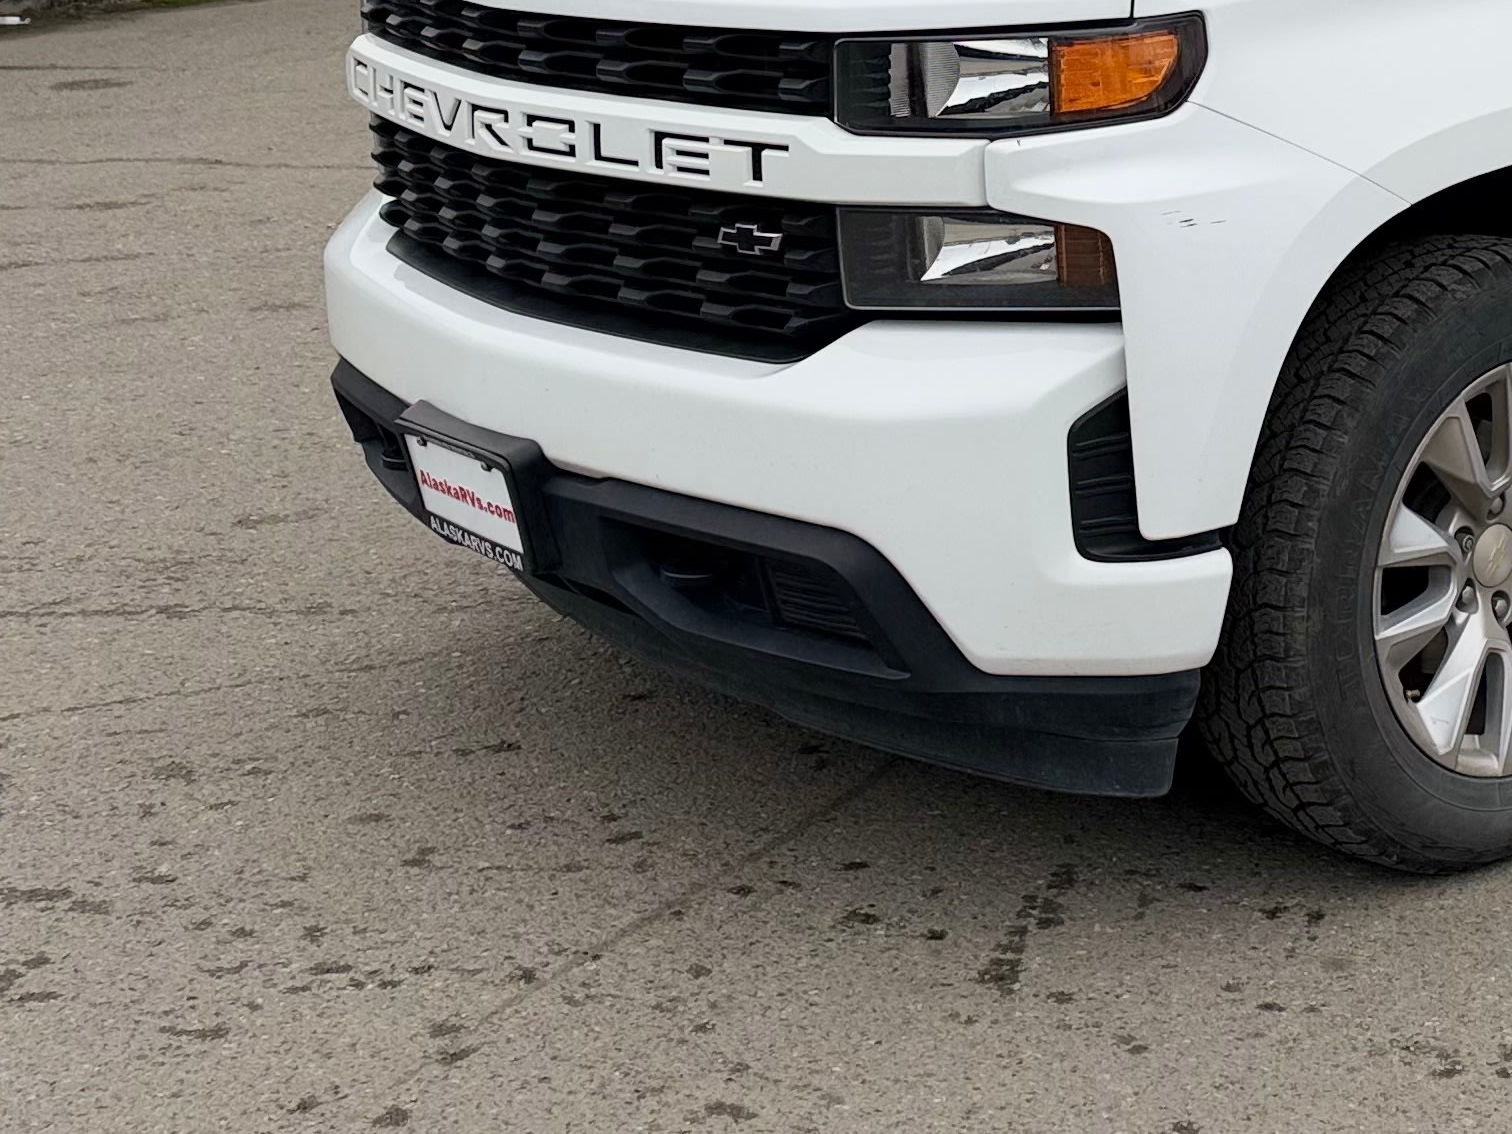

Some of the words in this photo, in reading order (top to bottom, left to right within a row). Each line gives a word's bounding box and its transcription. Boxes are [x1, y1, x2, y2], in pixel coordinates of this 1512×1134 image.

[351, 59, 791, 187] CHEVROLET
[419, 468, 516, 524] AlaskaRVs.com
[429, 515, 524, 572] ALASKARVS.COM
